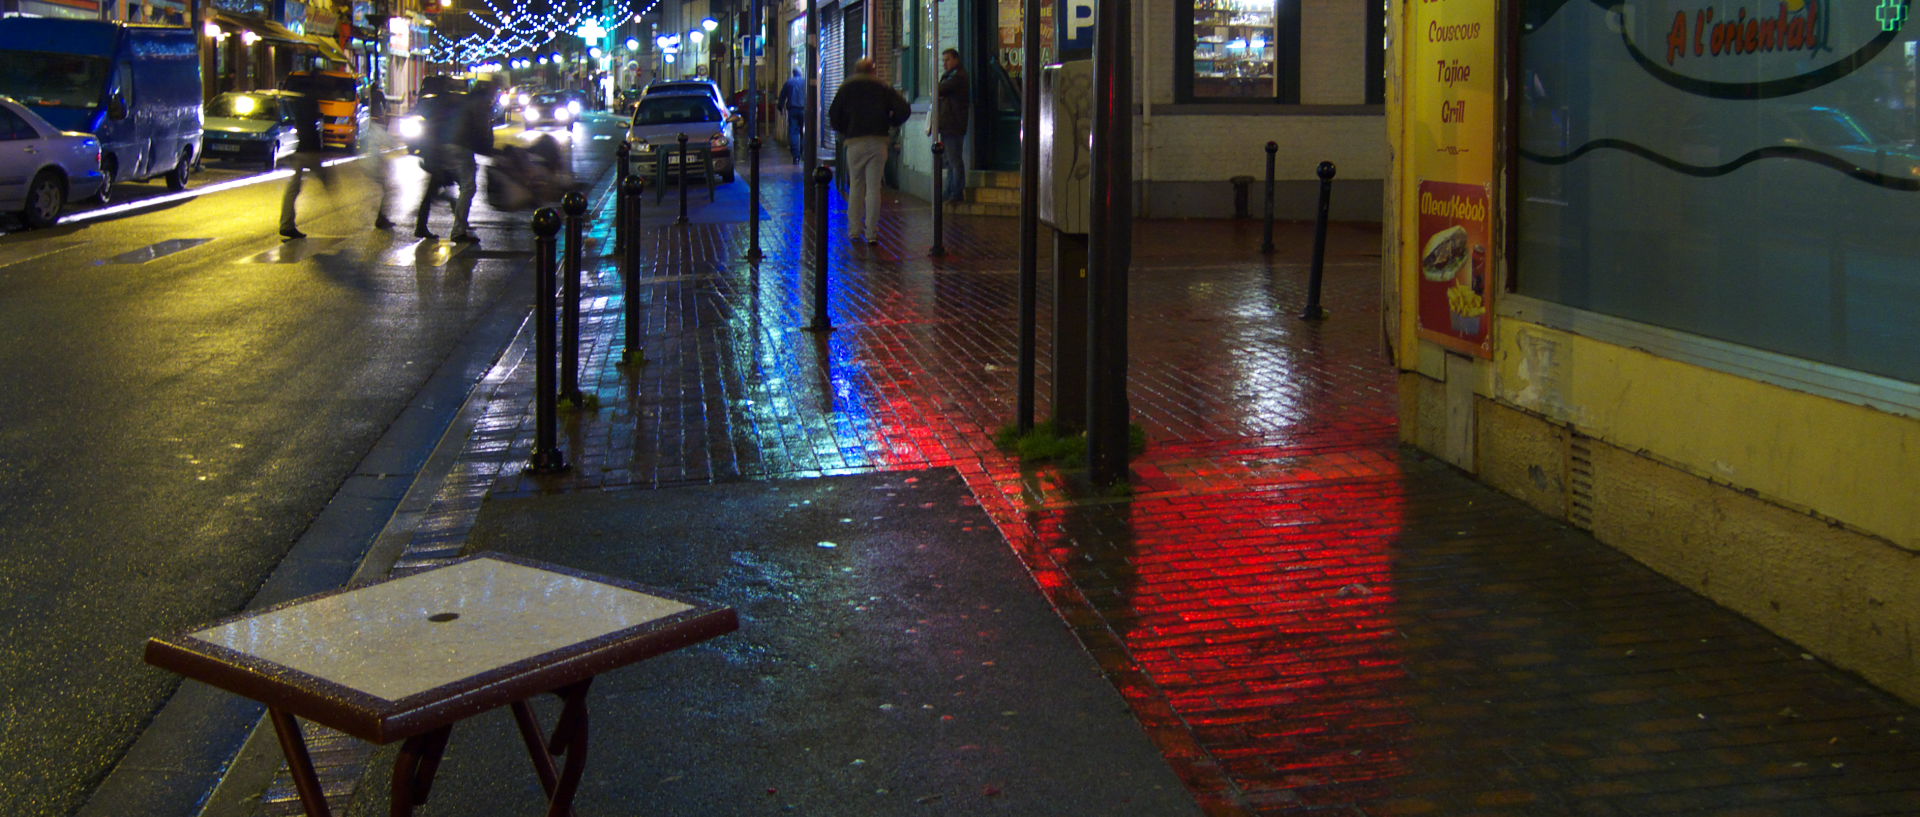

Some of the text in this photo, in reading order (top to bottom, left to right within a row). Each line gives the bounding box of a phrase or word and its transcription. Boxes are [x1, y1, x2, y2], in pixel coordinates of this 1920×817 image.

[1067, 0, 1095, 40] P
[1428, 20, 1481, 42] Couscous
[1666, 0, 1818, 65] A l'oriental
[1437, 58, 1471, 88] Tajine
[1441, 100, 1466, 123] Grill
[1421, 191, 1485, 223] Menu Kebab
